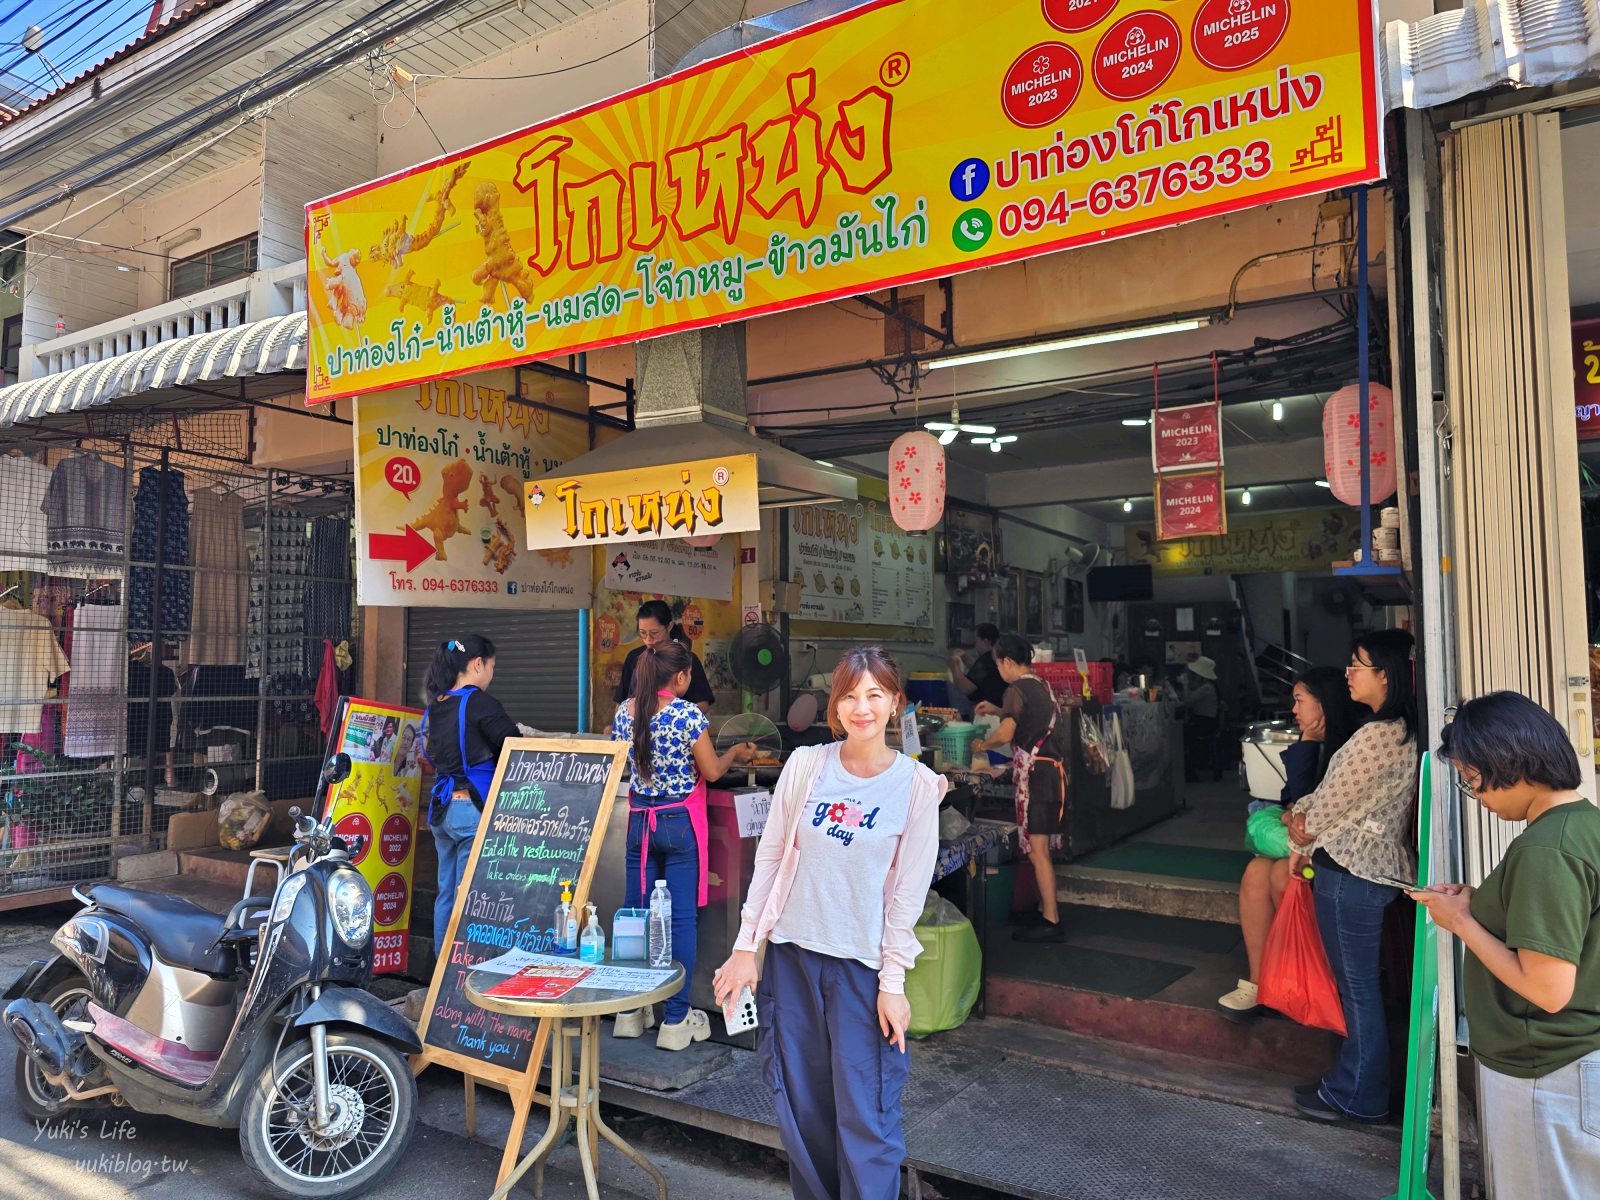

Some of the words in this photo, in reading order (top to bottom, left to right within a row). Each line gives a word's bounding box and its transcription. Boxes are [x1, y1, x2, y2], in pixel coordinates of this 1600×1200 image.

[1068, 0, 1098, 12] 20
[1203, 4, 1277, 37] MICHELIN
[1223, 26, 1260, 48] 2025
[1102, 37, 1170, 67] MICHELIN
[1121, 58, 1154, 79] 2024
[1011, 67, 1073, 96] MICHELIN
[1028, 88, 1058, 107] 2023
[995, 66, 1325, 190] ปาท่องโก๋โกเหน่ง
[513, 67, 893, 277] โกเหน่ง
[998, 139, 1273, 238] 094-6376333
[376, 424, 460, 458] ปาท่องโก๋
[1161, 424, 1212, 438] MICHELIN
[1175, 437, 1199, 447] 2023
[555, 469, 724, 539] โกเหน่ง
[1166, 494, 1214, 506] MICHELIN
[1179, 504, 1201, 515] 2024
[389, 571, 417, 591] โทร.
[422, 578, 498, 593] 094-6376333
[335, 834, 368, 842] MICHEN
[383, 834, 408, 842] MICHELIN
[826, 824, 855, 846] day
[486, 860, 503, 880] Take
[376, 891, 404, 901] MICHELIN
[464, 889, 514, 922] กลับบ้าน
[451, 941, 474, 966] Take
[435, 997, 462, 1028] along
[464, 1007, 486, 1028] with
[489, 1012, 505, 1034] the
[456, 1025, 486, 1050] Thank
[485, 1042, 510, 1059] you
